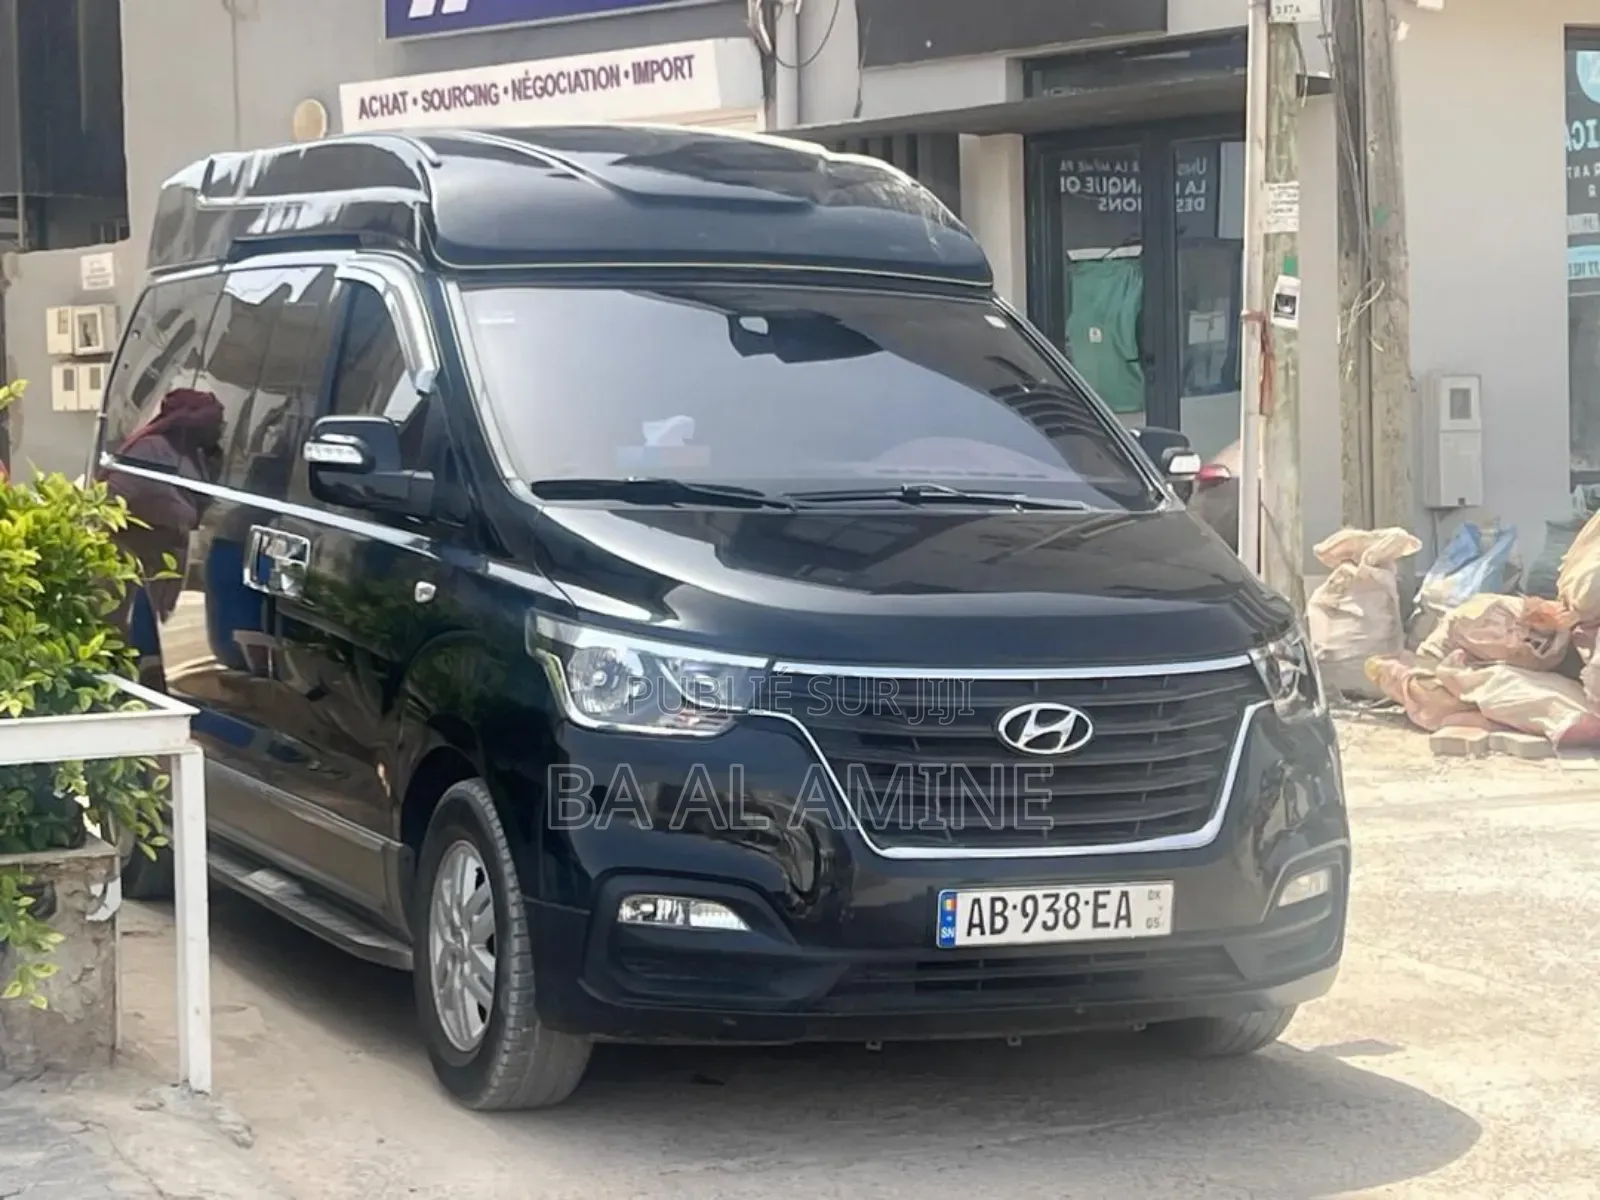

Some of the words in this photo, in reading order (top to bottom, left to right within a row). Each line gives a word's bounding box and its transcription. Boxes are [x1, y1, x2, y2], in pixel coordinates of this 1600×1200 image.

[358, 91, 409, 119] ACHAT
[421, 83, 500, 112] SOURCING
[511, 62, 621, 102] NÉGOCIATION
[632, 54, 695, 85] IMPORT
[940, 926, 955, 939] SN
